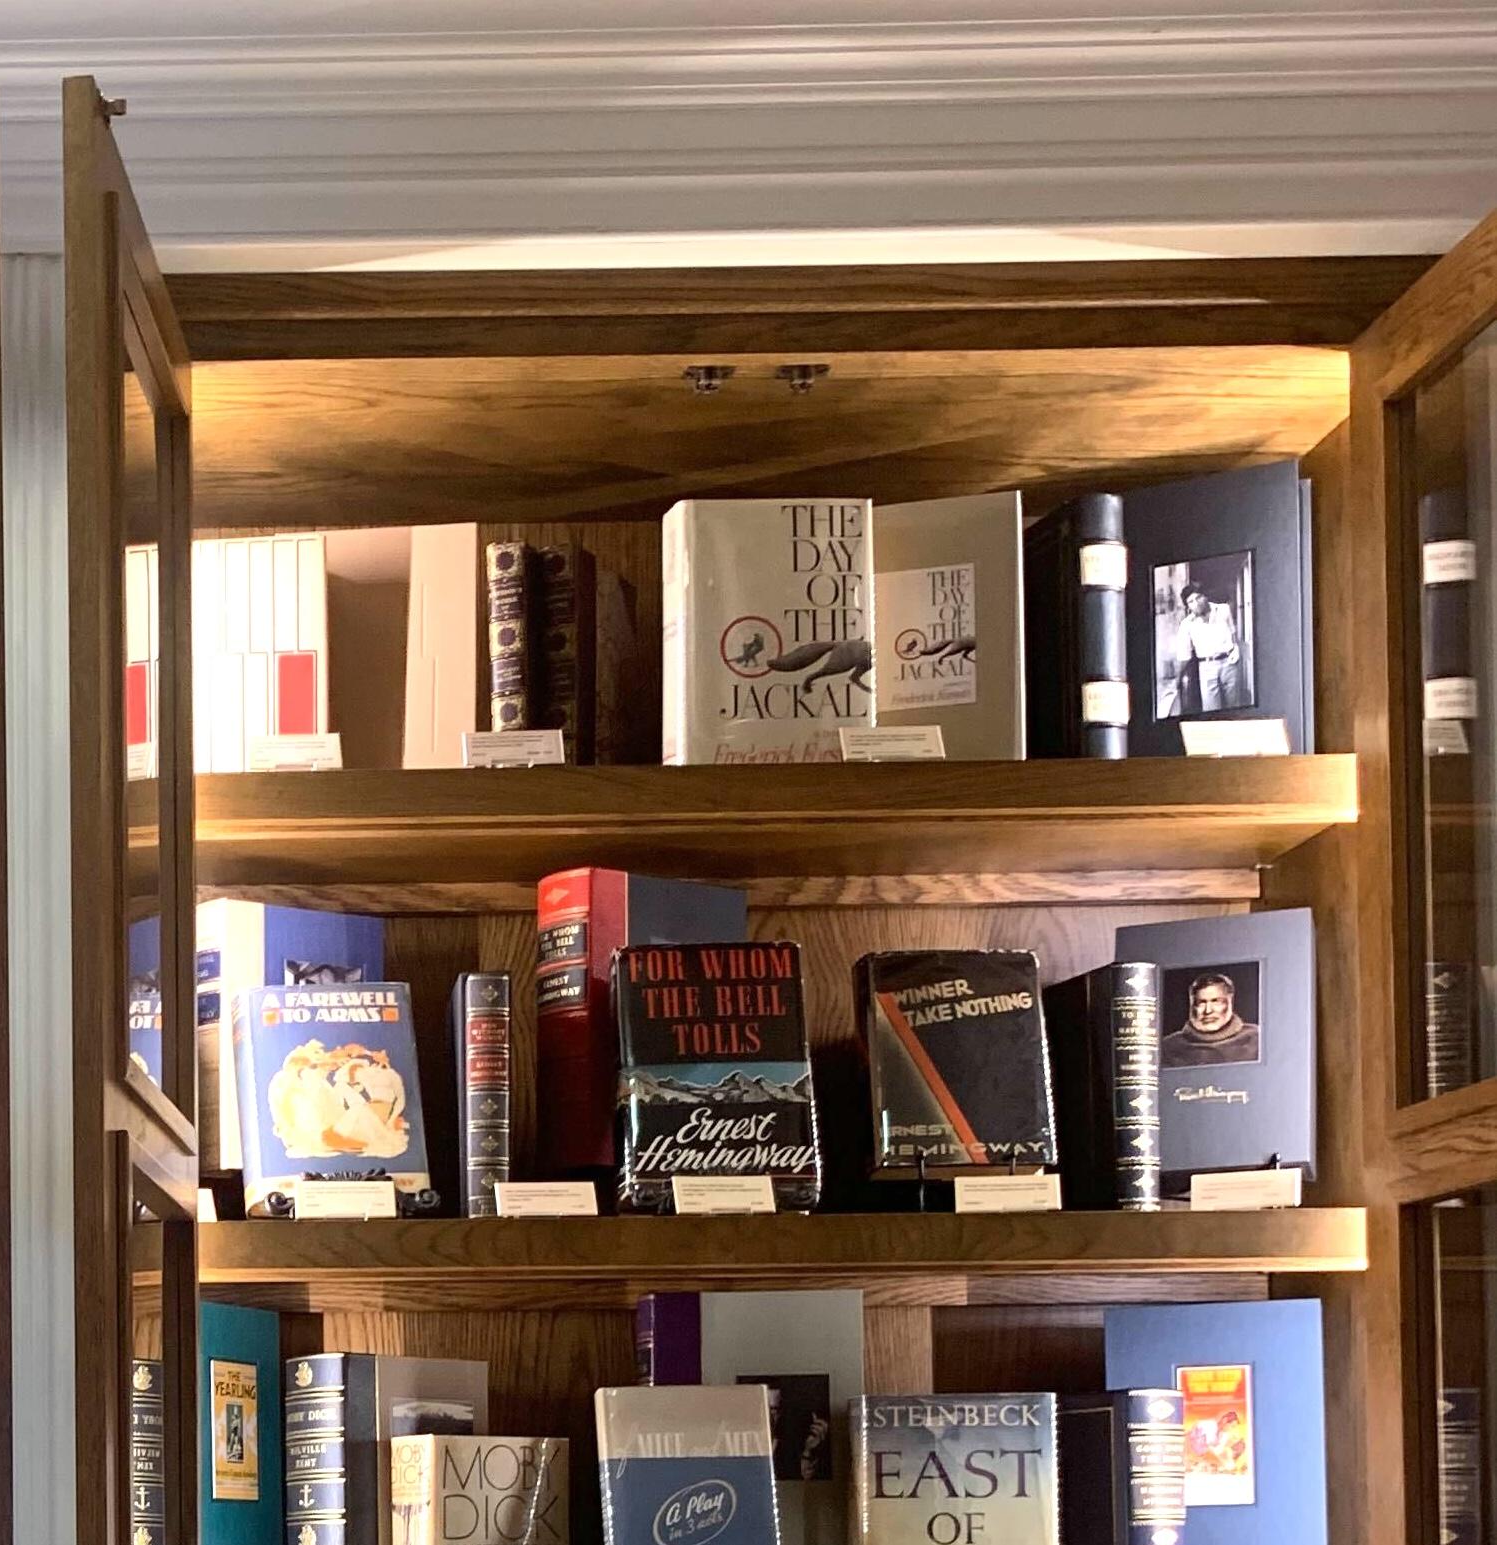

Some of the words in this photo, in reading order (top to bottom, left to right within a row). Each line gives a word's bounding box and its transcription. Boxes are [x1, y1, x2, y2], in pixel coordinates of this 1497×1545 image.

[781, 505, 863, 538] THE
[792, 540, 862, 573] DAY
[806, 574, 863, 608] OF
[928, 568, 970, 590] THE
[784, 608, 864, 642] THE
[939, 604, 969, 624] OF
[895, 660, 972, 682] JACKAL
[719, 683, 868, 720] JACKAL
[629, 950, 686, 983] FOR
[702, 948, 793, 980] WHOM
[262, 993, 281, 1008] A
[285, 991, 399, 1007] FAREWELL
[642, 986, 702, 1019] THE
[716, 985, 787, 1017] BELL
[891, 978, 975, 1006] WINNER
[281, 1008, 311, 1023] TO
[315, 1007, 382, 1023] ARMS
[903, 1004, 954, 1028] TAKE
[954, 992, 1034, 1019] NOTHING
[671, 1023, 762, 1056] TOLLS
[675, 1106, 778, 1145] Ernest
[634, 1135, 817, 1175] Hemingway
[215, 1381, 256, 1400] YEARLING
[228, 1371, 242, 1381] THE
[872, 1404, 1041, 1428] STEINBECK
[636, 1433, 685, 1458] MICE
[442, 1444, 560, 1491] MOBY
[870, 1450, 1042, 1498] EAST
[442, 1494, 560, 1540] DICK
[685, 1492, 724, 1519] Play
[669, 1526, 682, 1541] in
[686, 1519, 695, 1533] 3
[926, 1512, 985, 1545] OF
